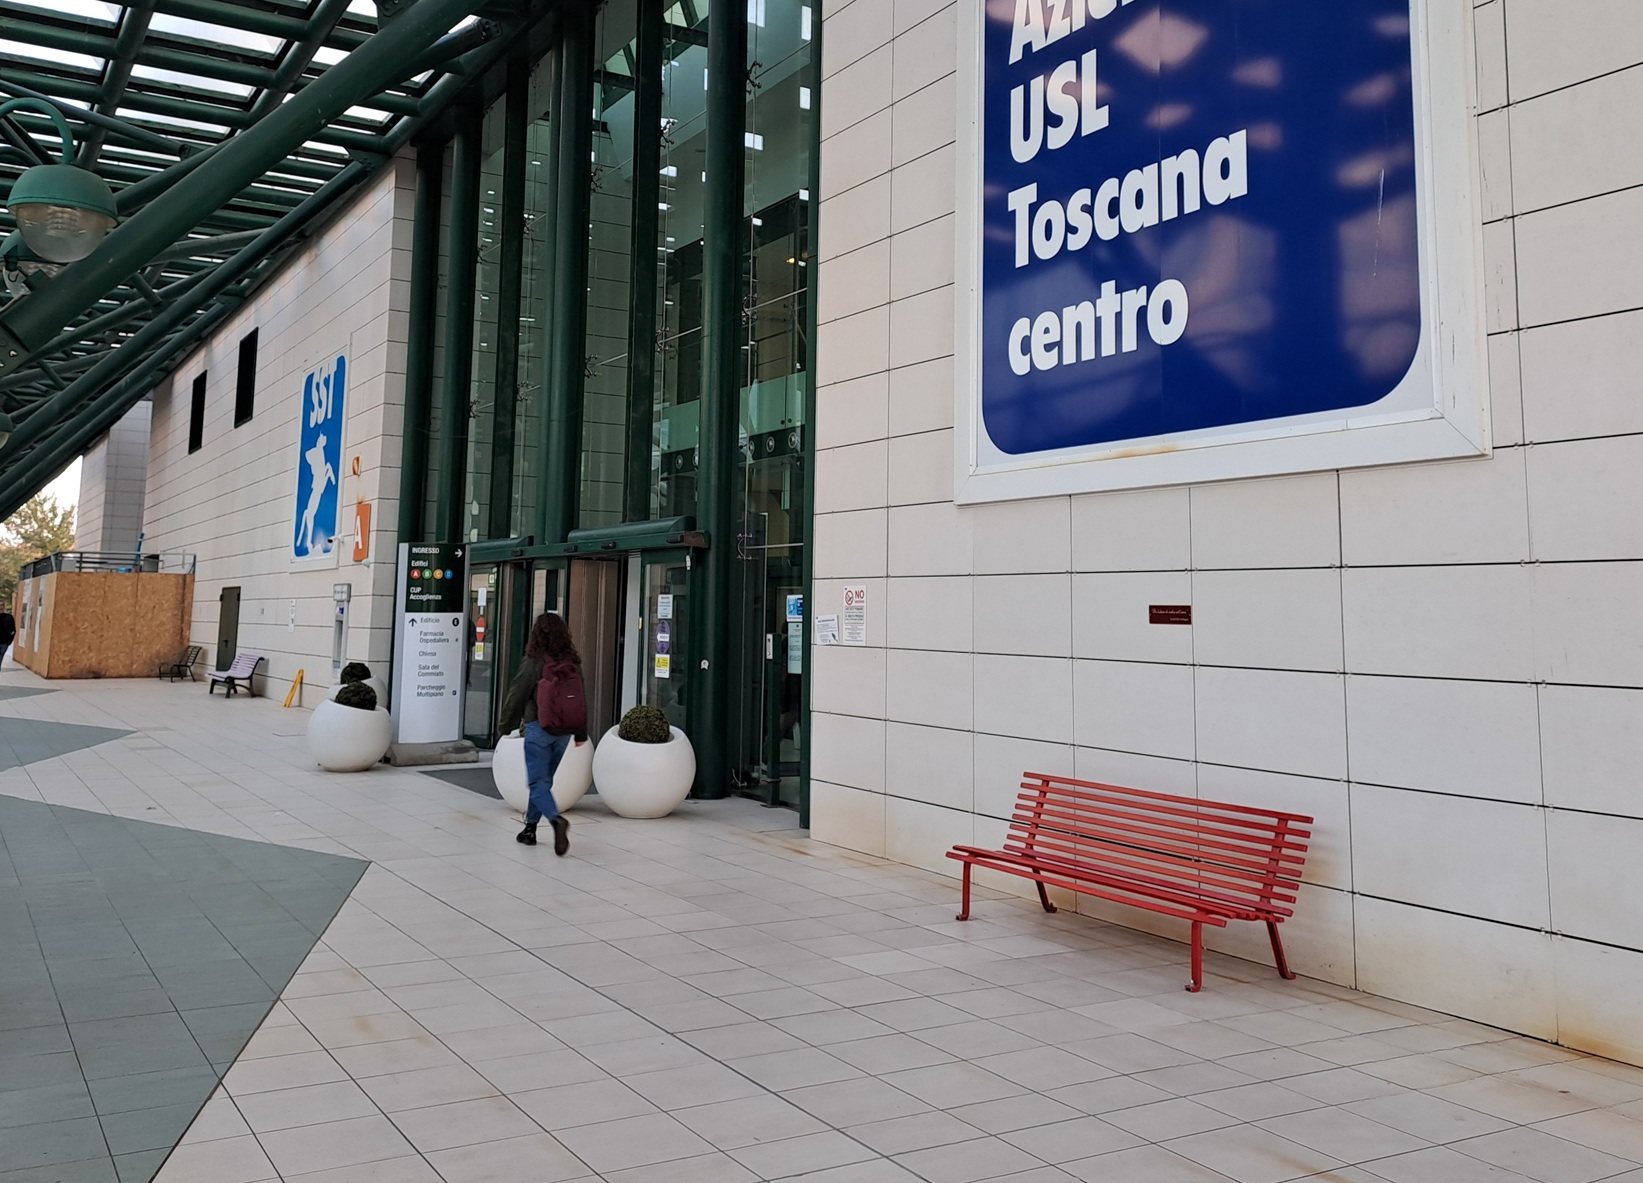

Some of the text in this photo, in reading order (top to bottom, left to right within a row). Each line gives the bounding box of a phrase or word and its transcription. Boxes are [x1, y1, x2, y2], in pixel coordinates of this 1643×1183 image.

[1009, 48, 1110, 163] USL
[1008, 129, 1248, 268] Toscana
[1008, 279, 1189, 375] centro
[309, 360, 338, 429] SST
[354, 515, 363, 550] A
[854, 590, 865, 599] NO
